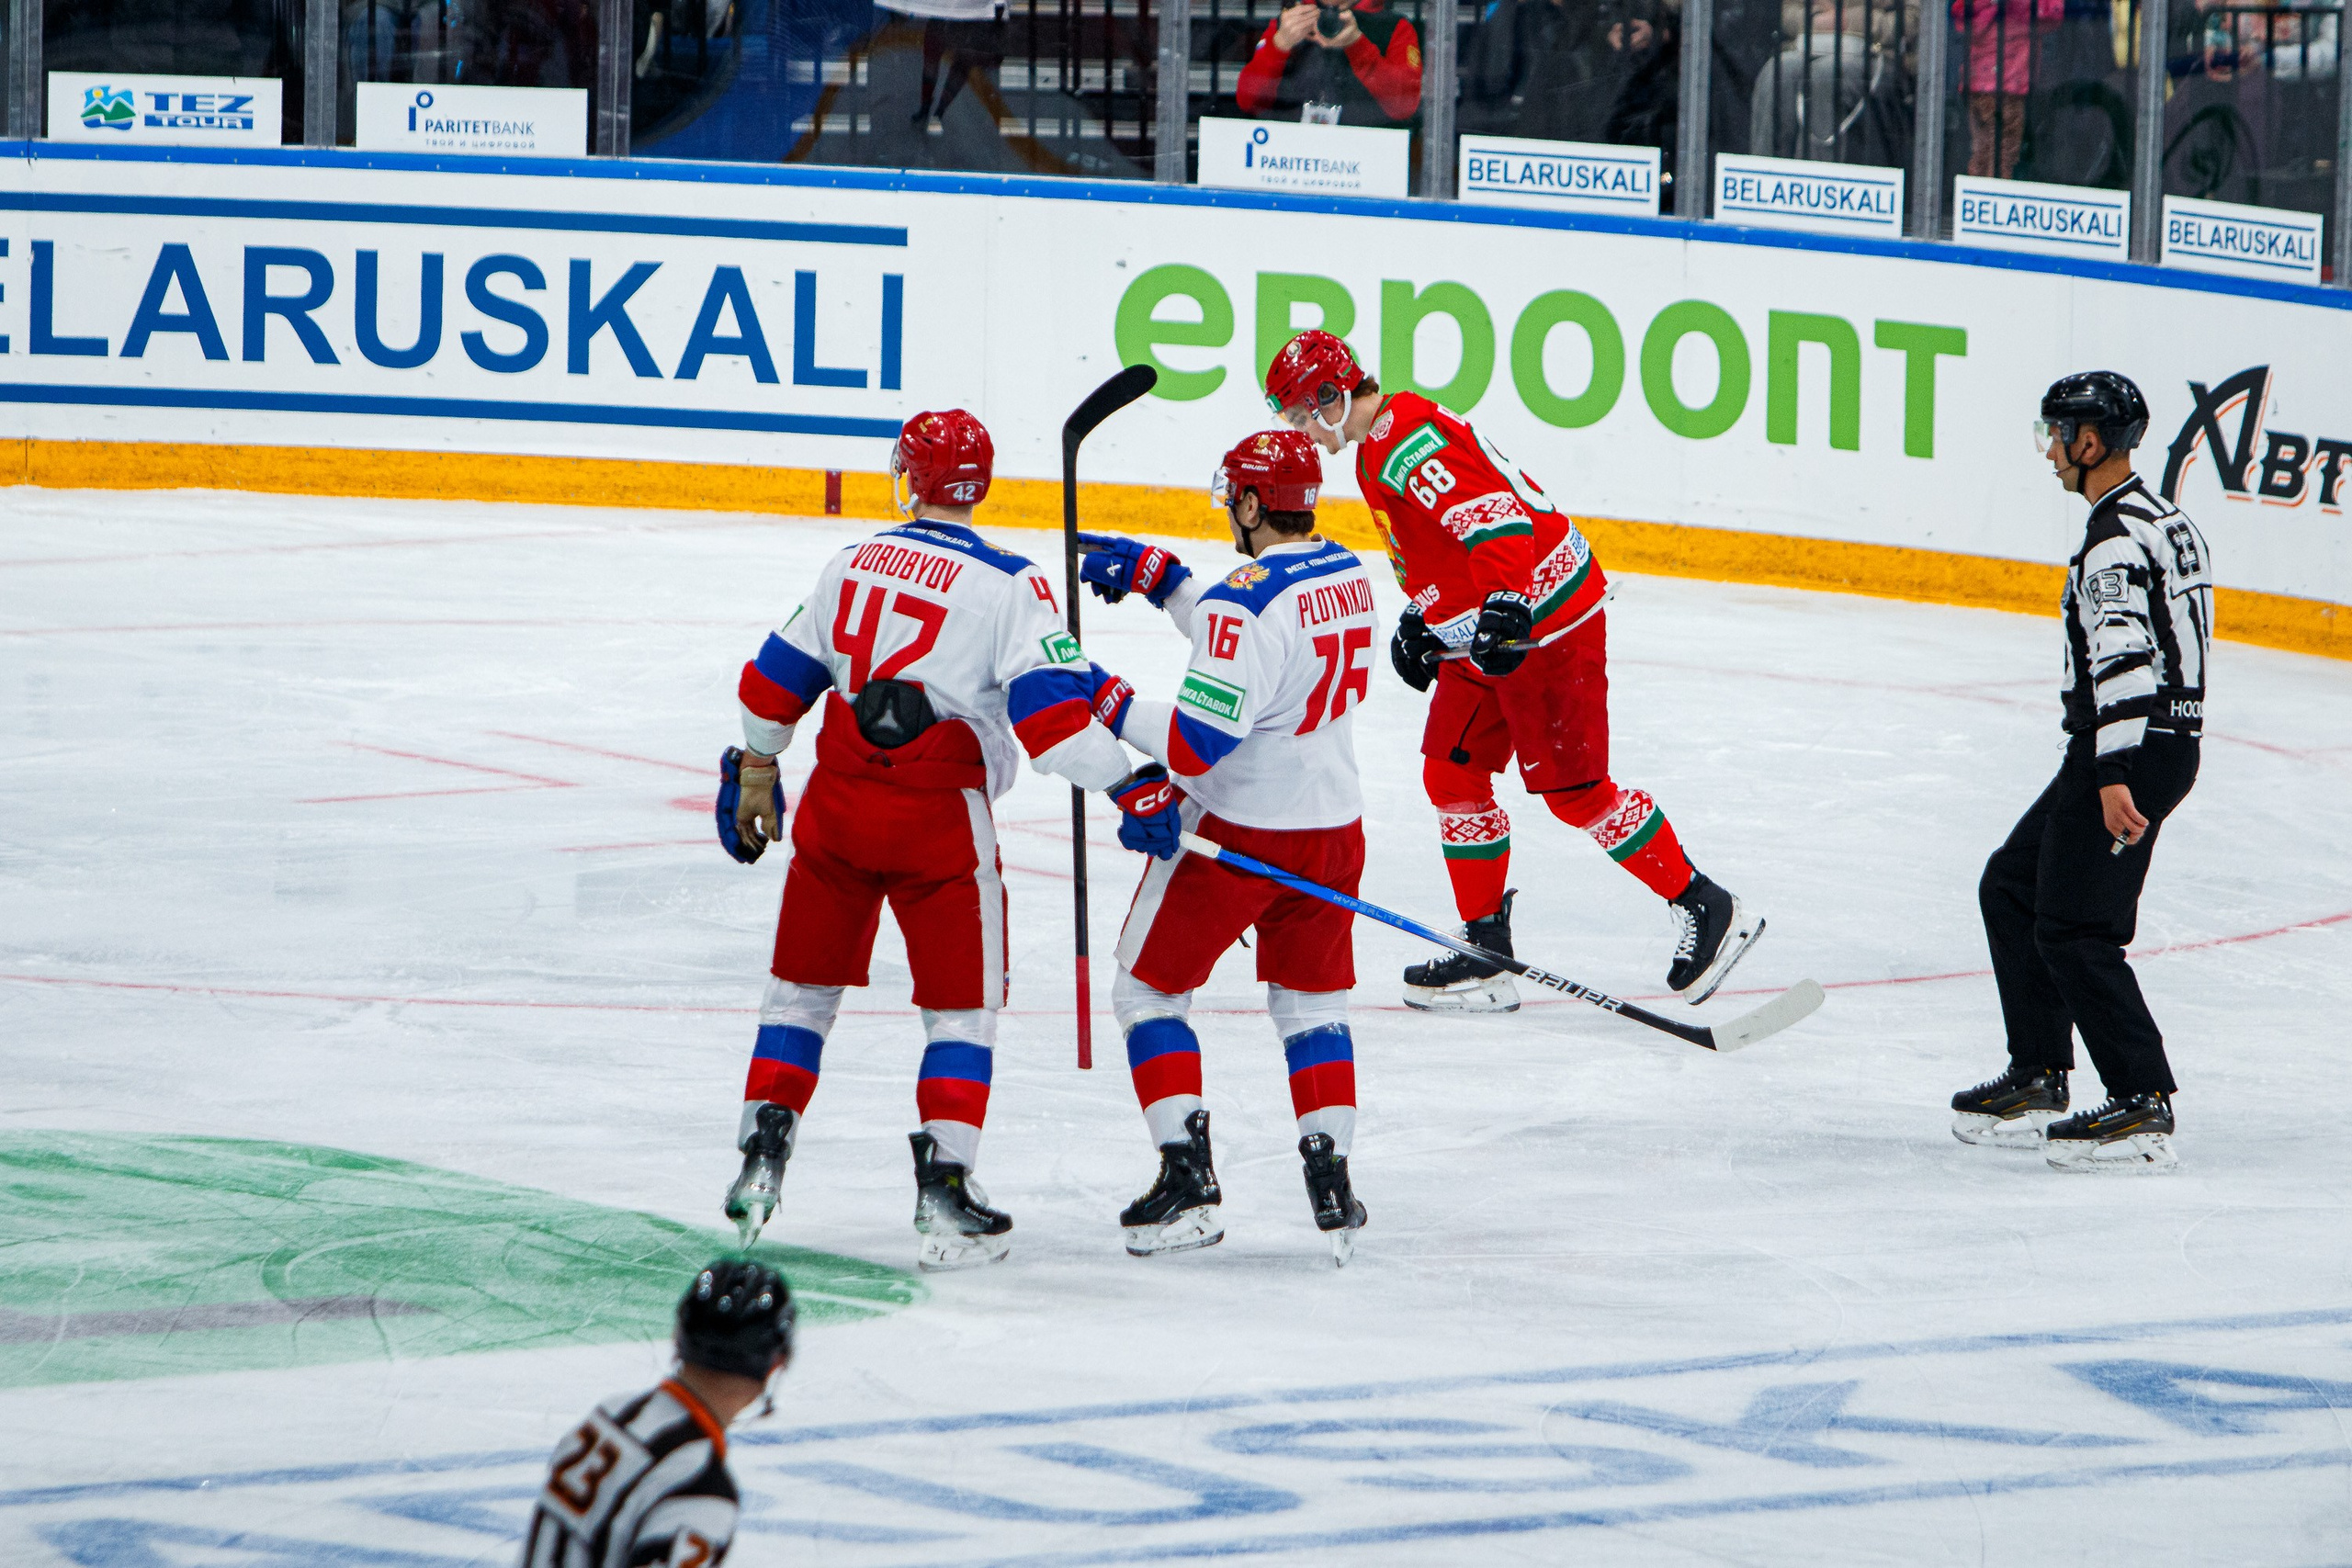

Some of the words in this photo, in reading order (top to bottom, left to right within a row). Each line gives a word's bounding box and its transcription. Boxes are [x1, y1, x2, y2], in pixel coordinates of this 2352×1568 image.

[145, 92, 254, 113] TEZ
[153, 115, 244, 128] TOUR
[425, 118, 535, 135] PARITETBANK
[1261, 155, 1361, 175] PARITETBANK
[1468, 158, 1651, 193] BELARUSKALI
[1723, 176, 1895, 215] BELARUSKALI
[1962, 198, 2121, 238] BELARUSKALI
[2168, 220, 2315, 261] BELARUSKALI
[0, 237, 904, 390] LARUSKALI
[1241, 463, 1269, 471] BAUER
[1408, 458, 1456, 510] 68
[953, 485, 976, 502] 42
[1304, 487, 1317, 505] 16
[850, 543, 964, 593] VOROBYOV
[1297, 577, 1374, 628] PLOTNIKOV
[2088, 570, 2124, 606] 83
[832, 578, 948, 694] 42
[1207, 613, 1244, 660] 16
[1135, 784, 1173, 812] CC
[1333, 893, 1404, 927] HYPERLITE
[1521, 965, 1623, 1012] BAUER
[549, 1422, 620, 1517] 23
